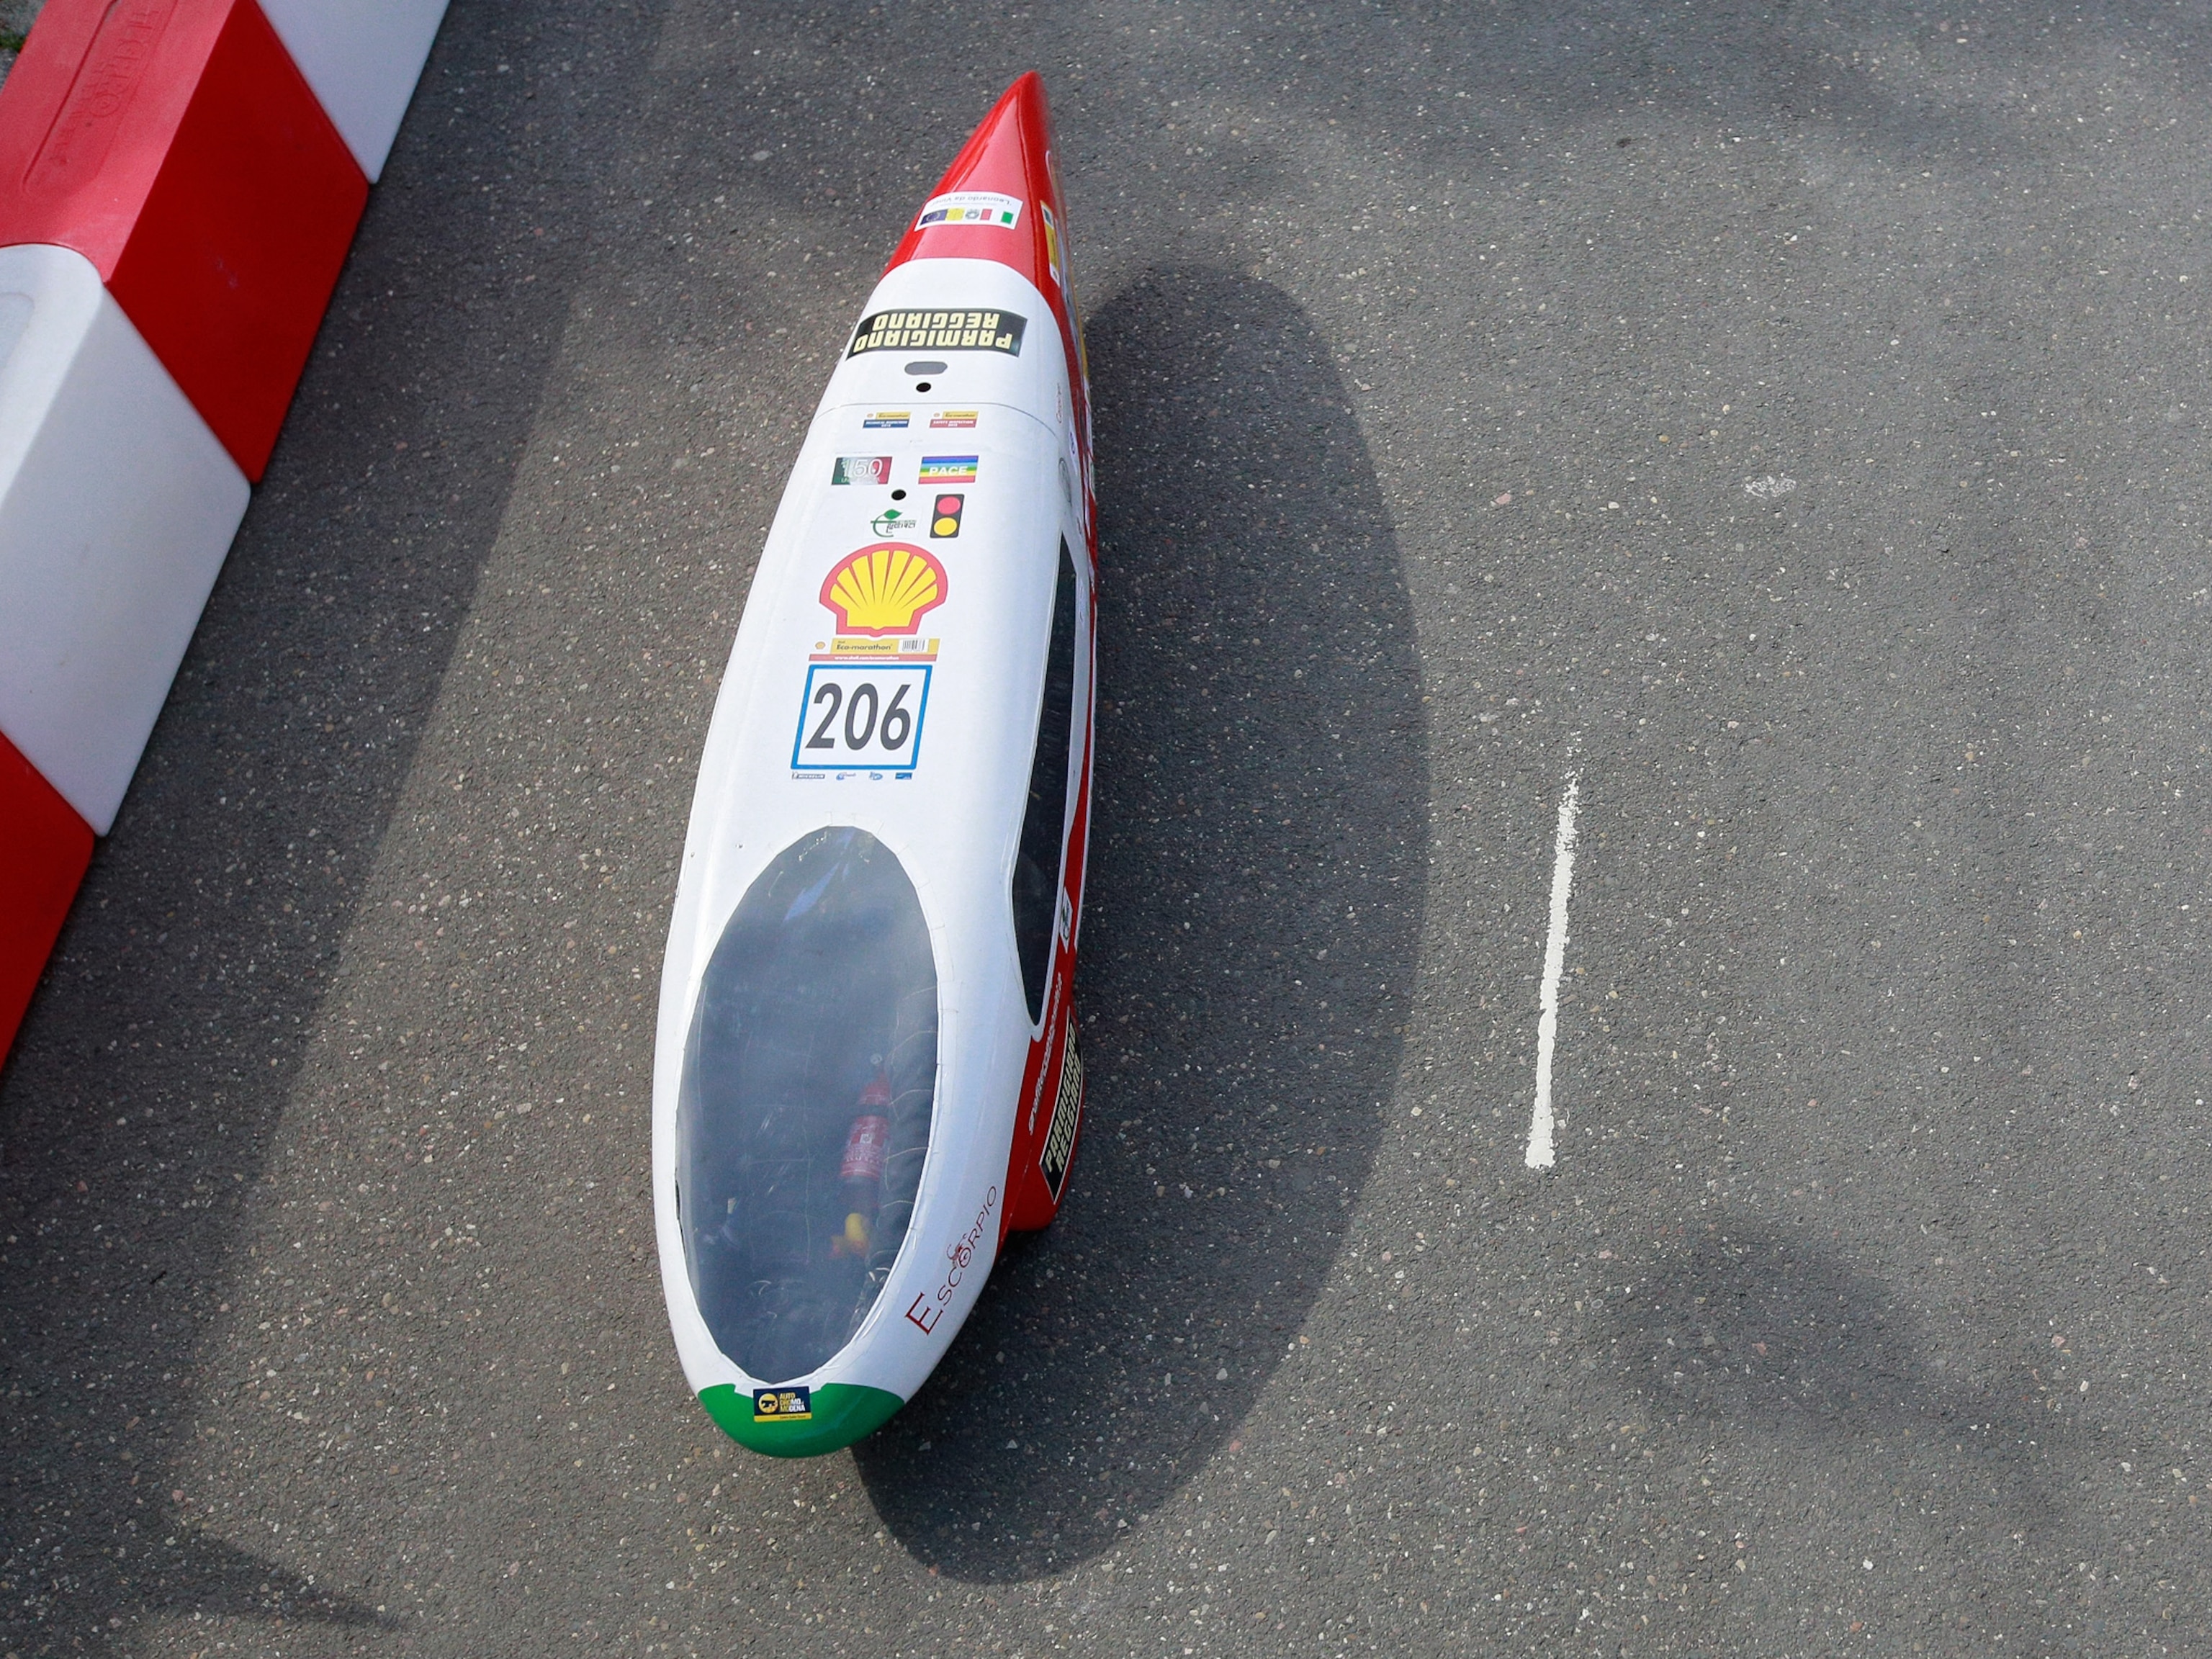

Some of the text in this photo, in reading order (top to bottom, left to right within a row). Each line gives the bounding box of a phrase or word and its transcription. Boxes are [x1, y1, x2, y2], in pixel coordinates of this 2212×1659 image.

[872, 313, 1000, 329] REGGIANO
[853, 331, 1013, 353] PARMIGIANO
[840, 458, 883, 477] 150
[928, 465, 968, 475] PACE
[805, 683, 911, 750] 206
[1045, 1022, 1076, 1173] PARMIGIANO
